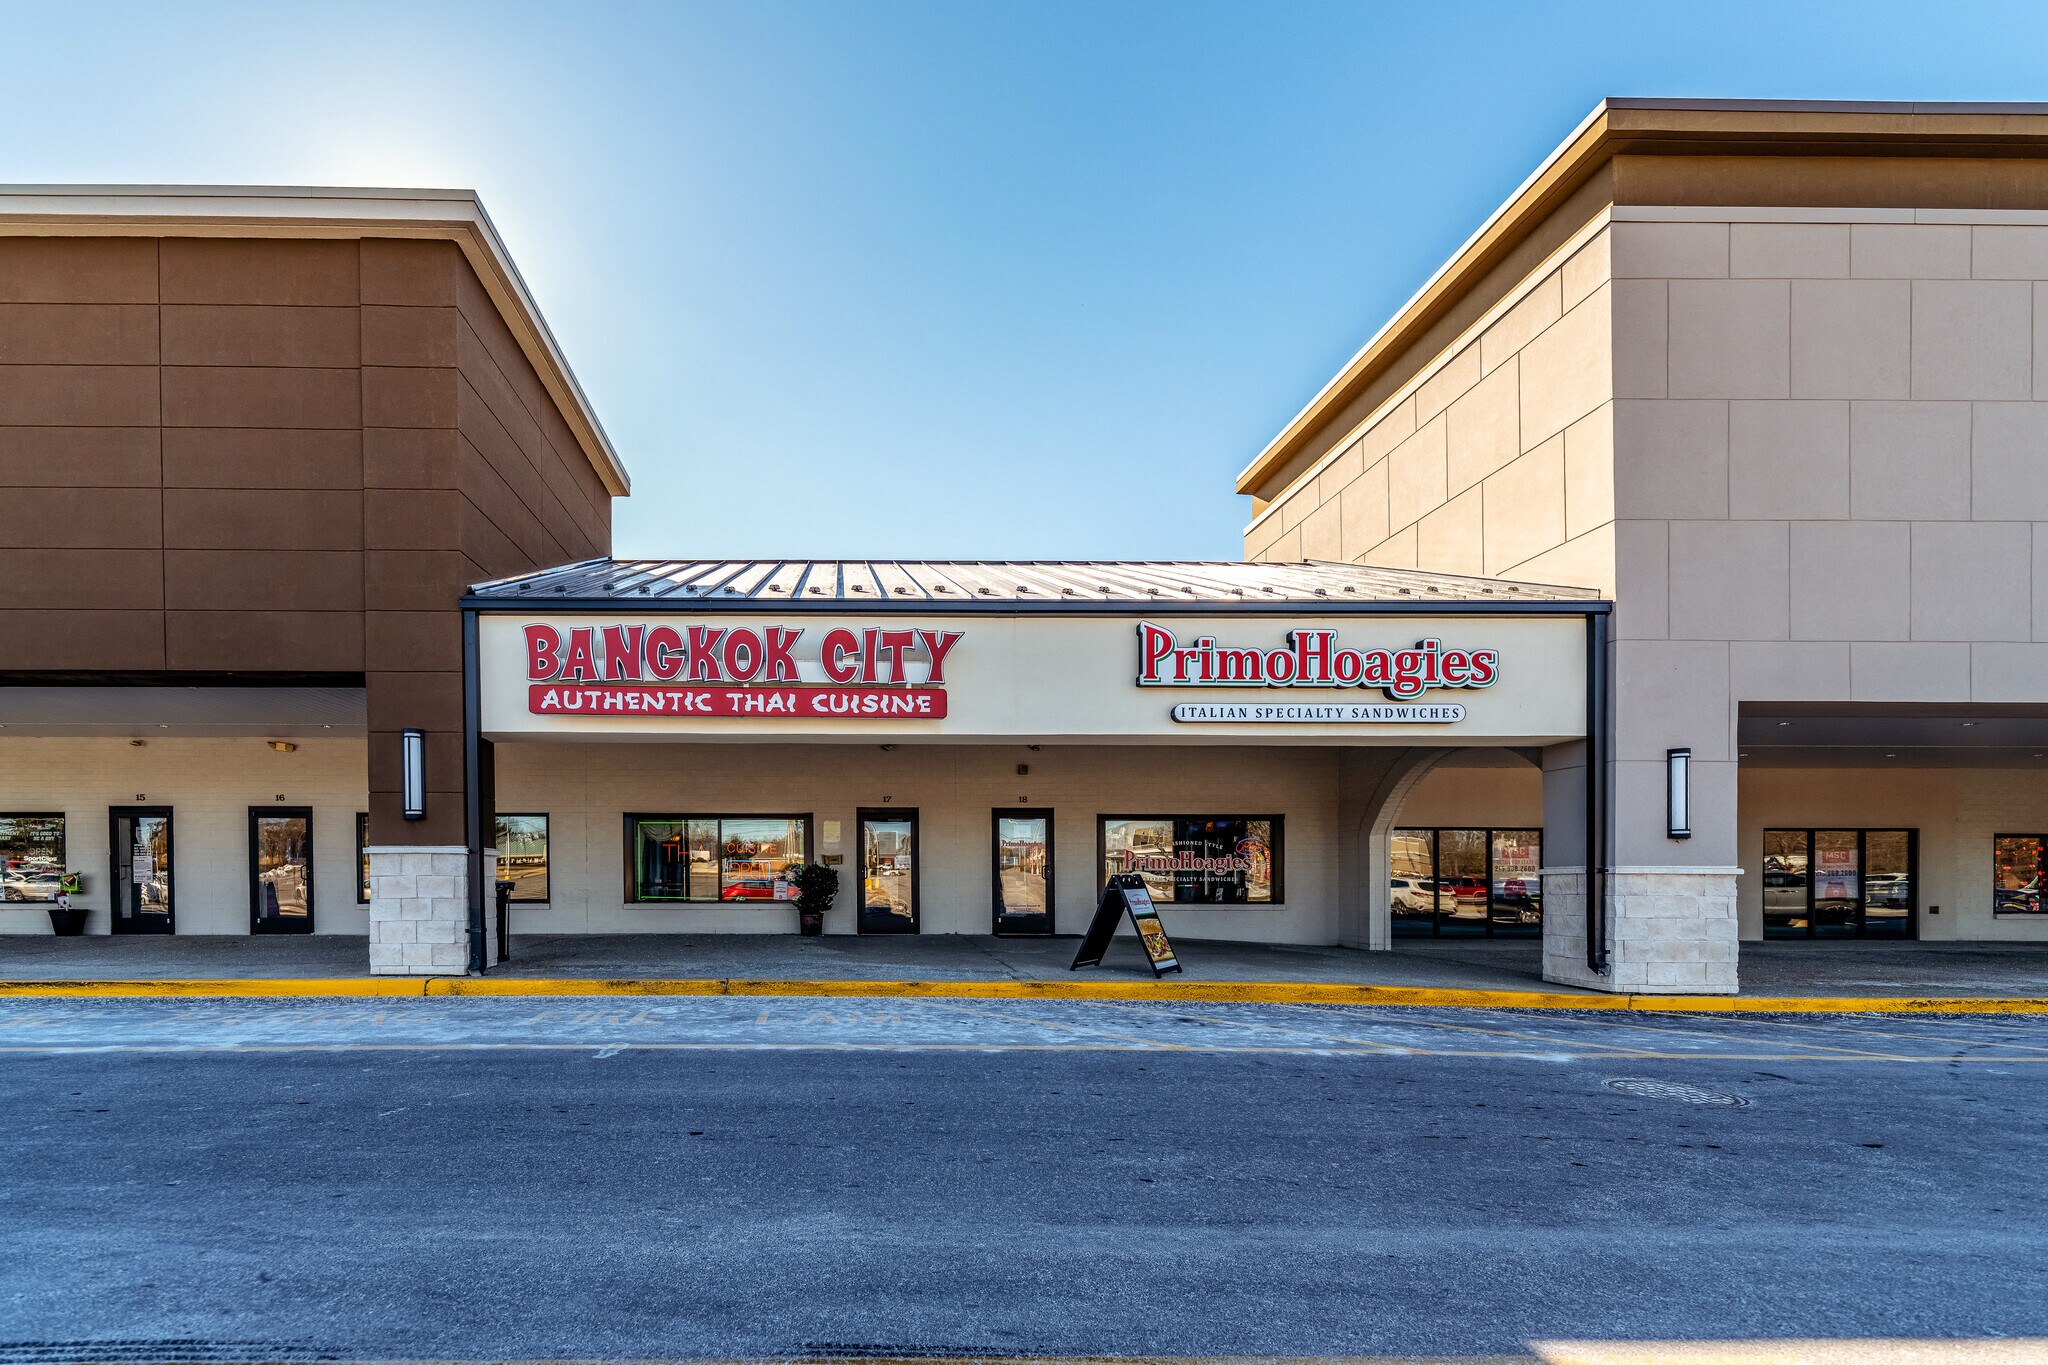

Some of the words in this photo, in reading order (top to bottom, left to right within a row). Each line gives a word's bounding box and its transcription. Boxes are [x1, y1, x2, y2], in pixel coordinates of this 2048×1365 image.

[522, 624, 805, 684] BANGKOK
[820, 627, 965, 685] CITY
[1140, 624, 1498, 701] PrimoHoagies
[540, 688, 712, 713] AUTHENTIC
[726, 691, 796, 713] THAI
[811, 693, 932, 714] CUISINE
[1180, 706, 1248, 719] ITALIAN
[1255, 707, 1345, 719] SPECIALTY
[1352, 707, 1461, 720] SANDWICHES
[135, 793, 146, 801] 15
[882, 795, 892, 803] 17
[29, 847, 54, 856] OPEN
[1825, 851, 1846, 860] MSC
[728, 861, 769, 880] OPEN
[1124, 850, 1252, 875] PrimoHoagies
